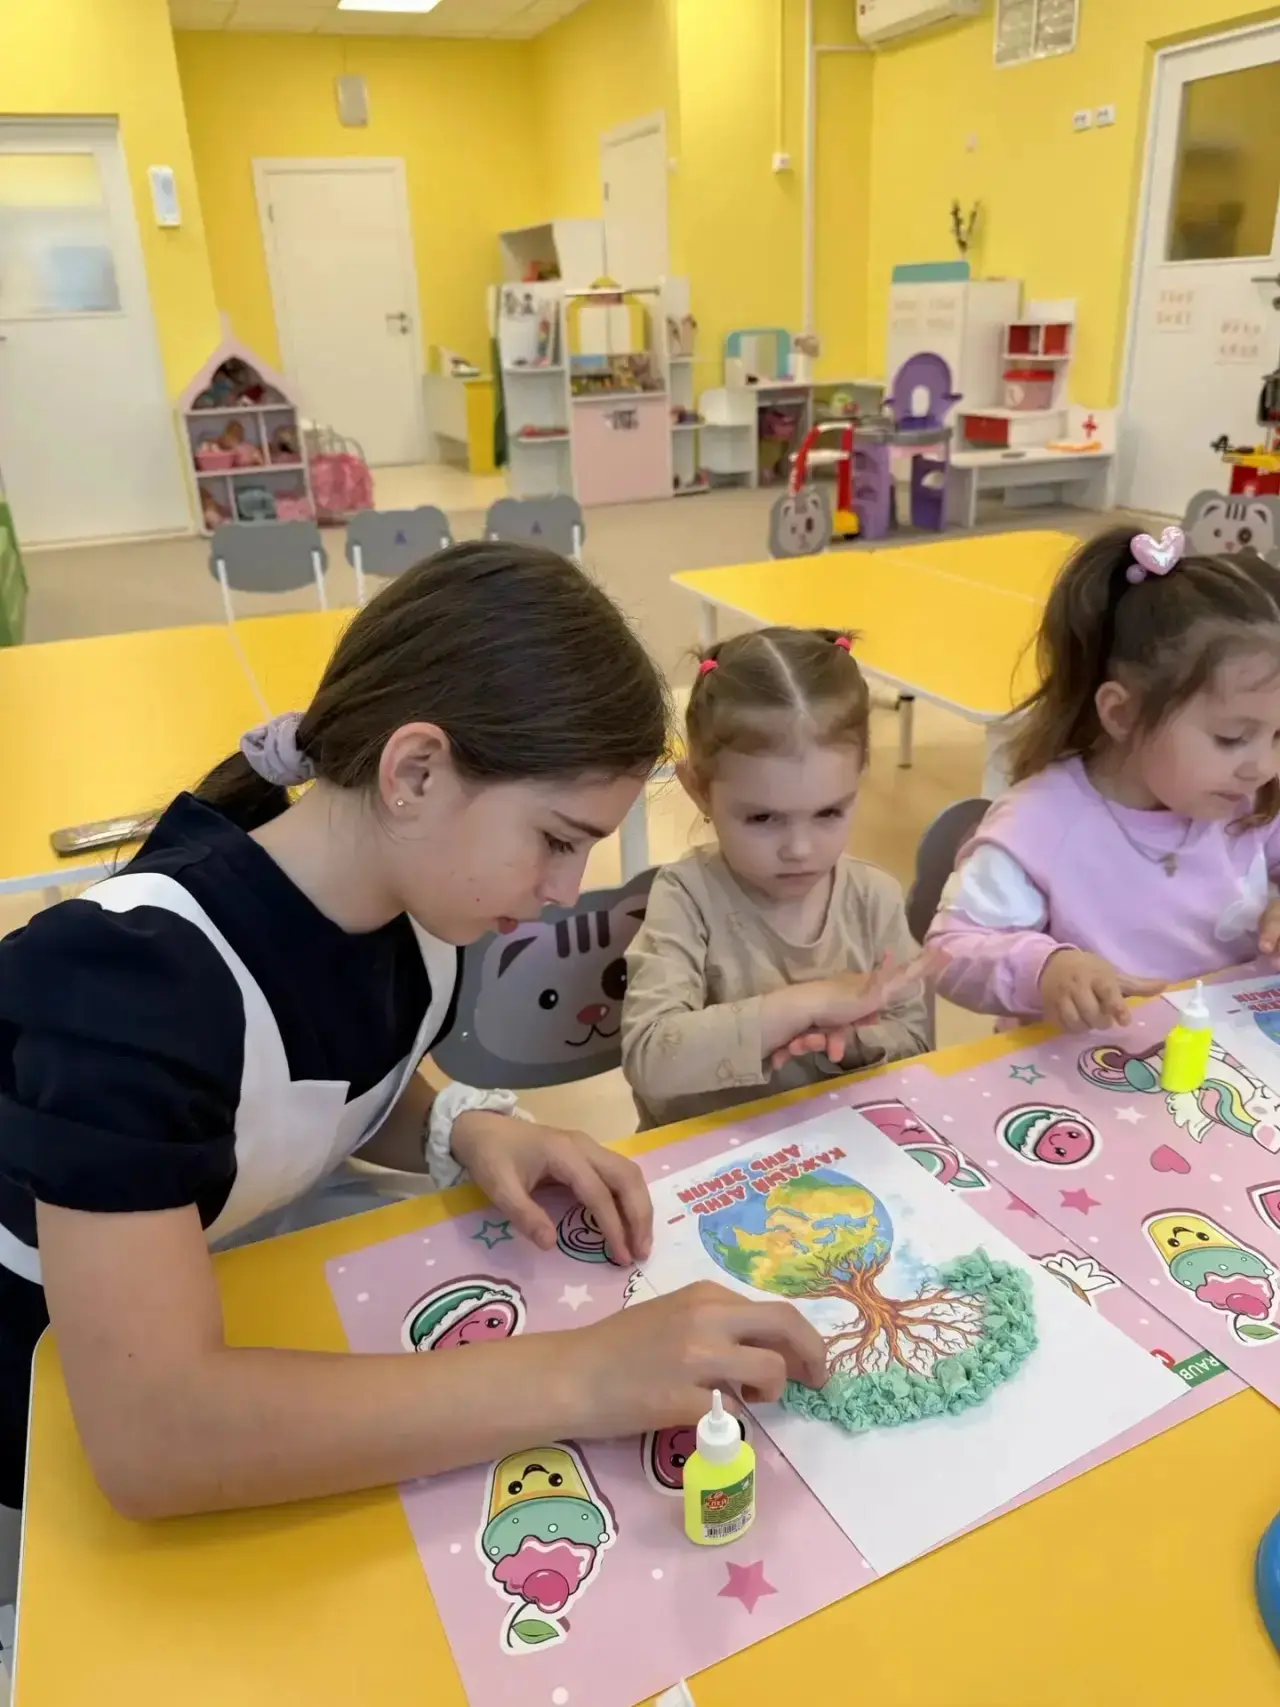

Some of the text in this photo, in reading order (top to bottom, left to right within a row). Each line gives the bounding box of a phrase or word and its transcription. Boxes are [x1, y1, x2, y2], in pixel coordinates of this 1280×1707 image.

[1231, 989, 1280, 1003] ЕМЛИ
[676, 1144, 801, 1204] ДЕНЬ ЗЕМЛИ
[751, 1147, 847, 1194] КАЖДЫЙ
[691, 1186, 746, 1214] ДЕНЬ
